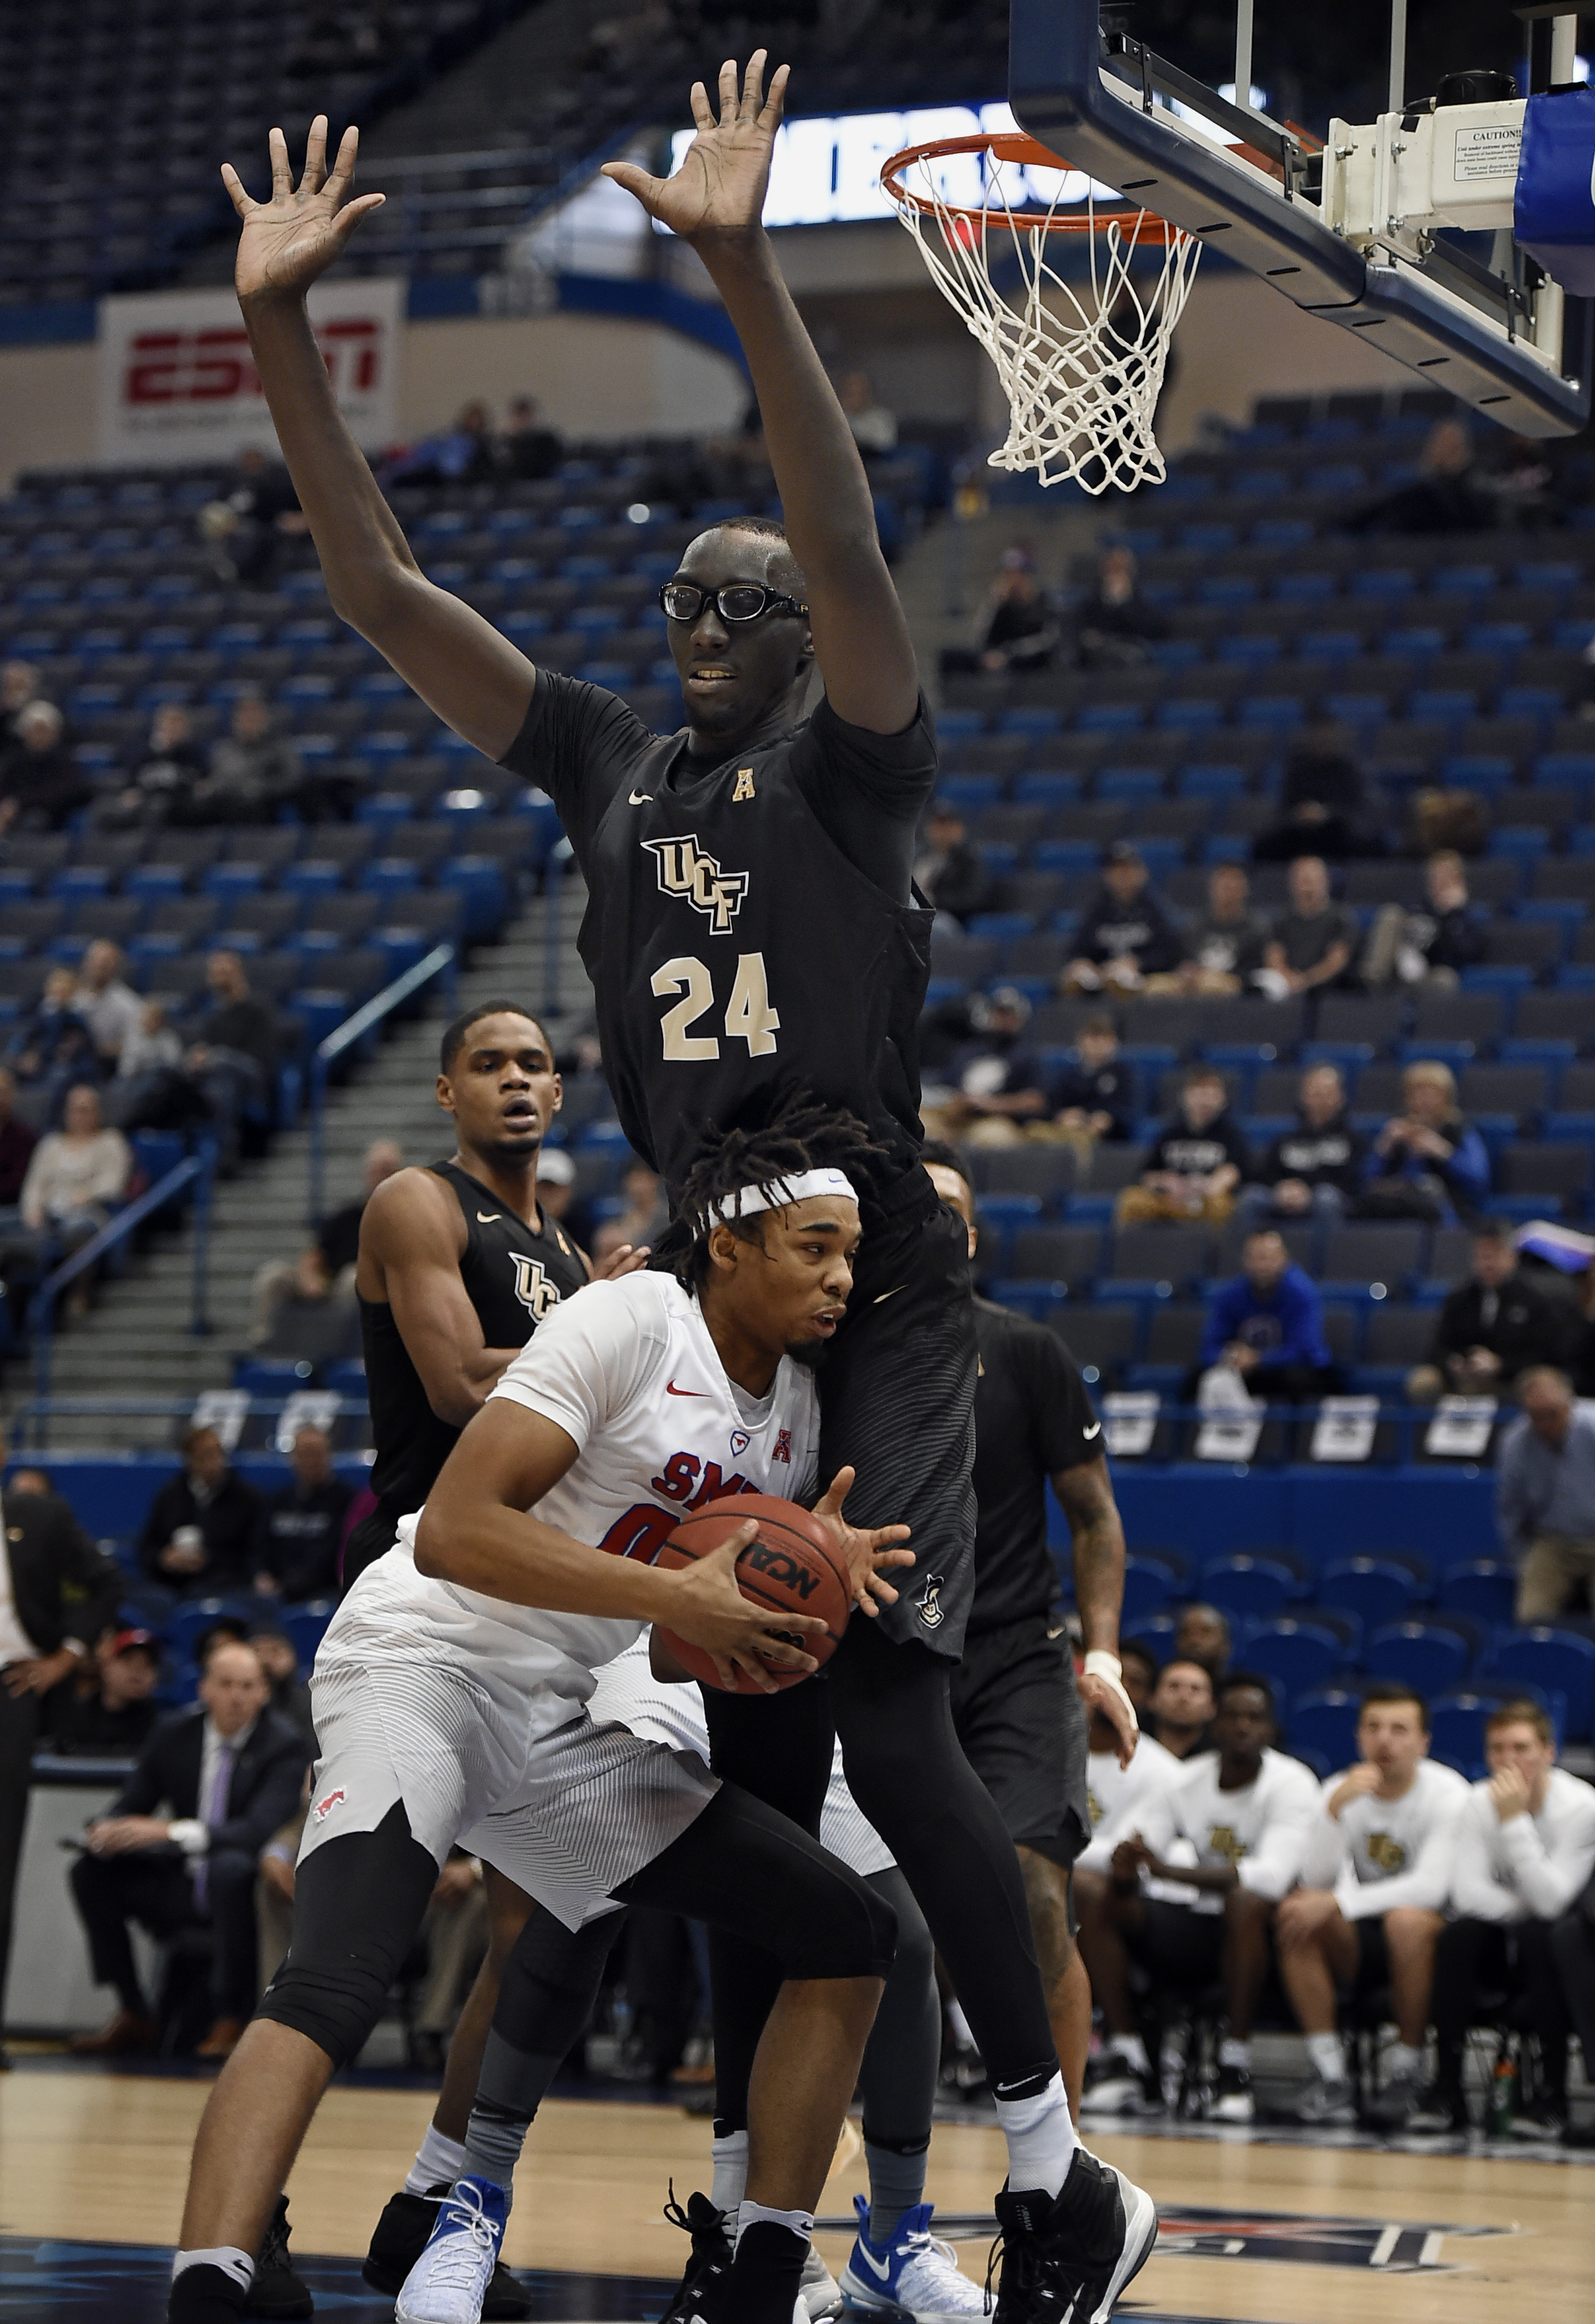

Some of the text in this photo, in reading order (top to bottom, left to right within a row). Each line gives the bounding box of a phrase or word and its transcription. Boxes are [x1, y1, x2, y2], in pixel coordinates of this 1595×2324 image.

[127, 319, 377, 403] ESN
[644, 835, 748, 934] UCF
[650, 951, 781, 1060] 24
[512, 1253, 560, 1322] UC
